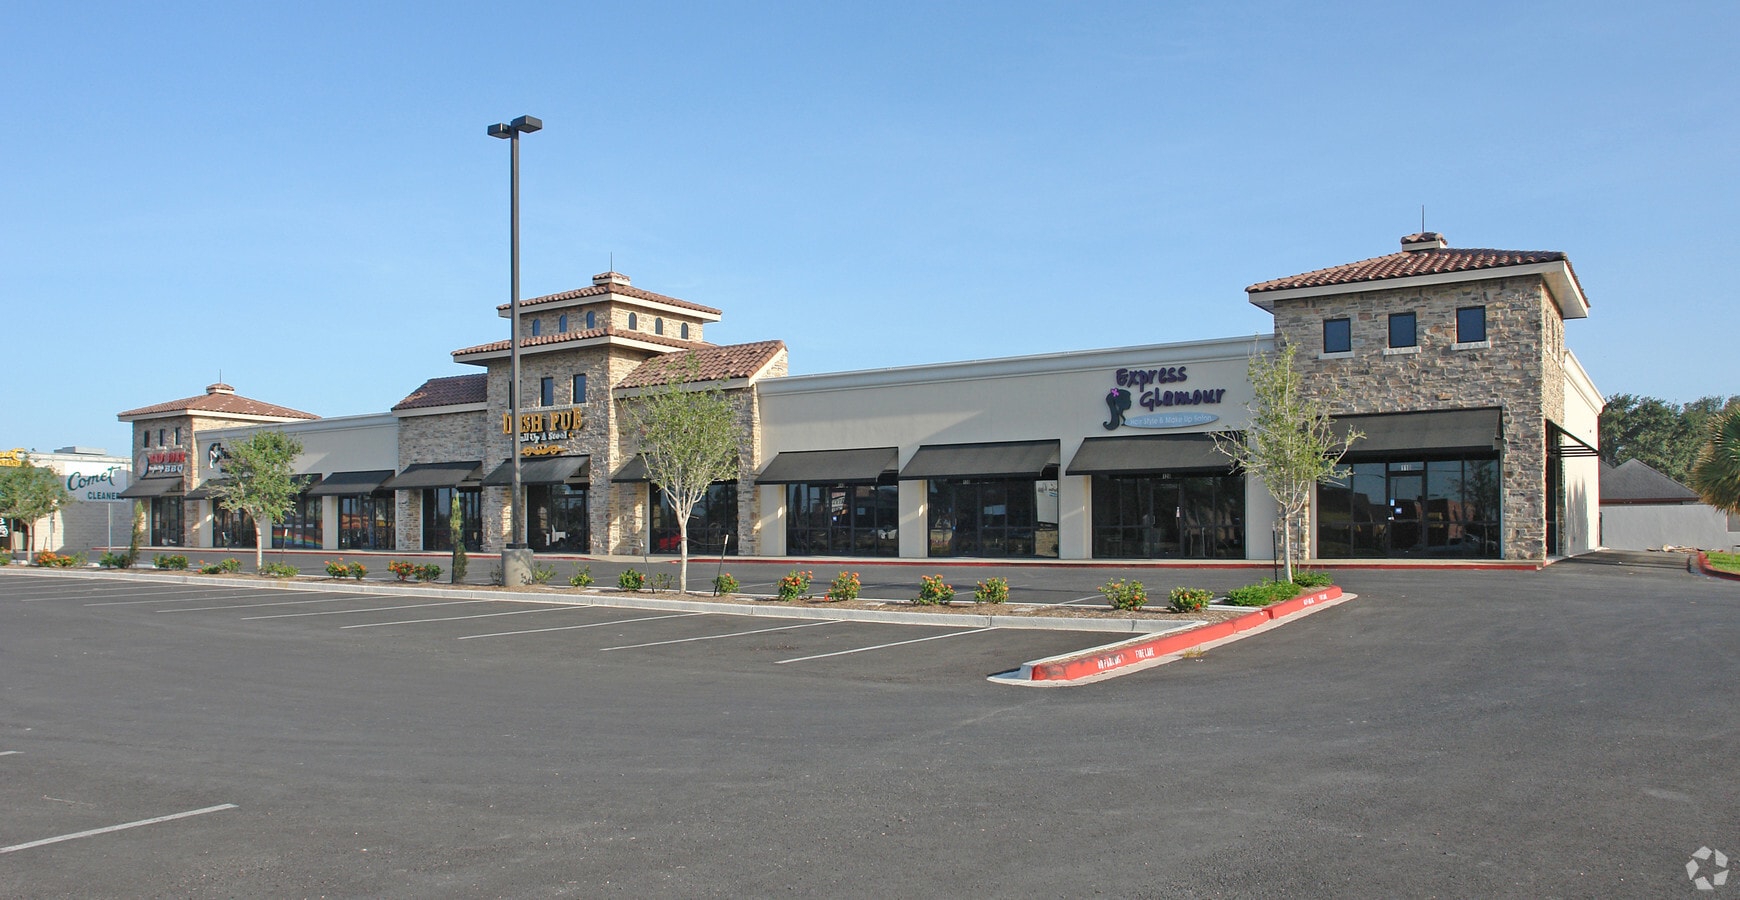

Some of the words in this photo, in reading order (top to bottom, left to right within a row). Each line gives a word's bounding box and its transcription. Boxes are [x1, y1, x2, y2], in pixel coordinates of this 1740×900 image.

[1116, 366, 1188, 393] Express
[1140, 387, 1226, 412] Glamour
[550, 407, 582, 431] PUB
[67, 466, 121, 491] Comet
